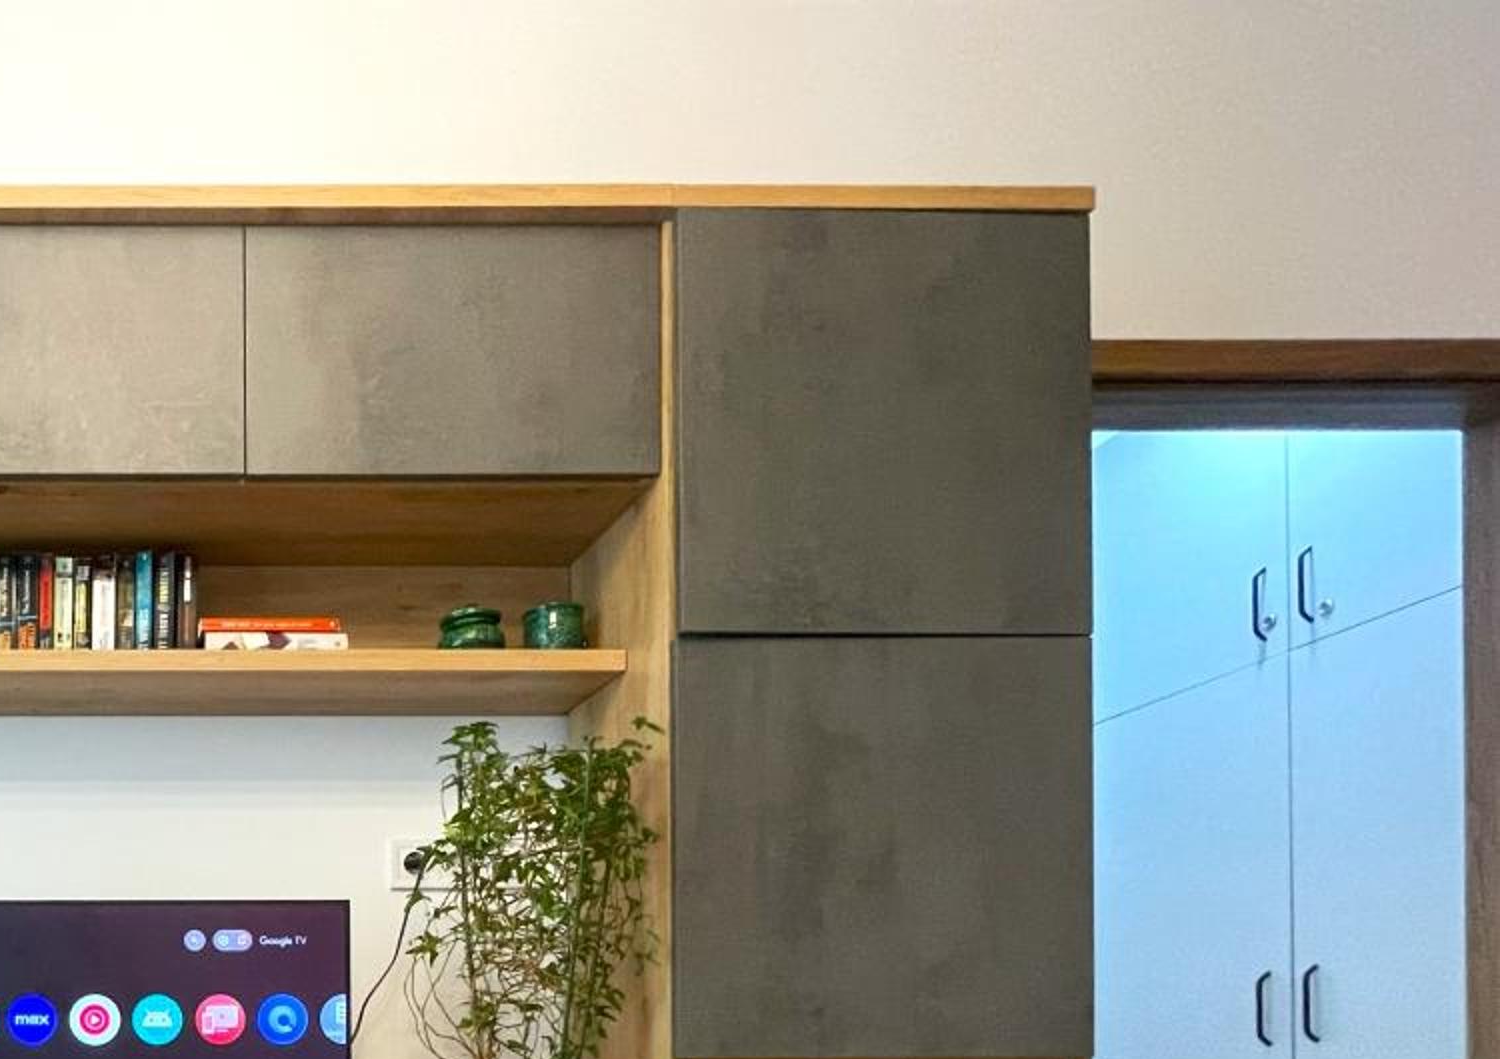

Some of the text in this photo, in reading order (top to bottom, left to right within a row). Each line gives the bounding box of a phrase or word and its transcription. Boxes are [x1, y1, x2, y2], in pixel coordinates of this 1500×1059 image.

[259, 935, 308, 948] Google TV
[15, 1014, 50, 1026] max
